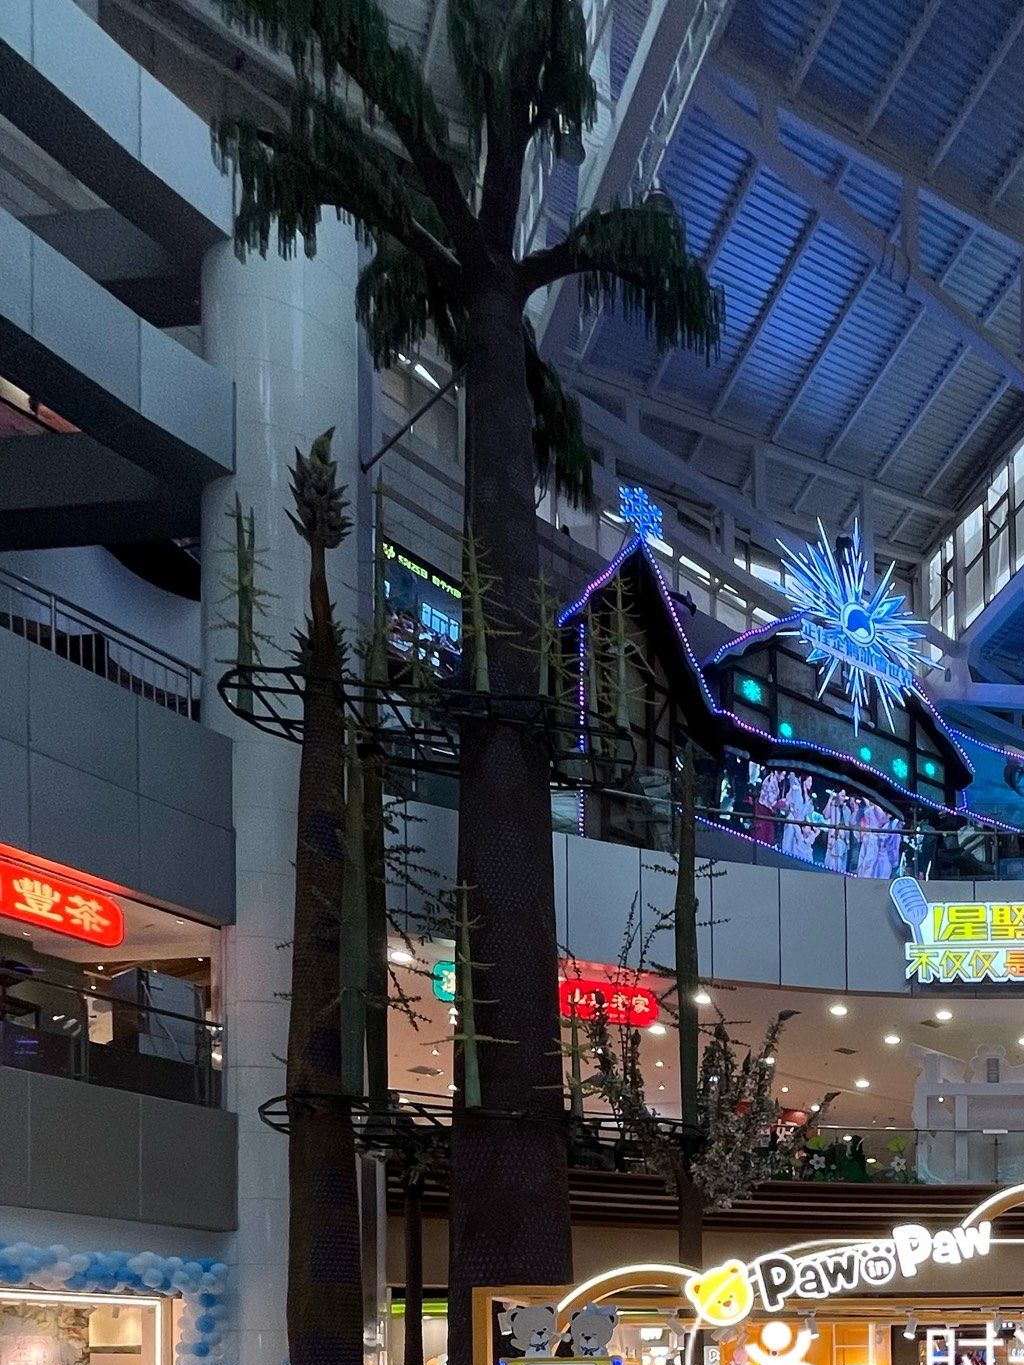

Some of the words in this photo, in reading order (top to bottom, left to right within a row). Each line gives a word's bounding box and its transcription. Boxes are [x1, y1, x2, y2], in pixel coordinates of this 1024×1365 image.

[0, 874, 111, 933] 豐茶
[758, 1253, 858, 1311] Paw
[865, 1257, 888, 1279] in
[892, 1222, 992, 1278] Paw
